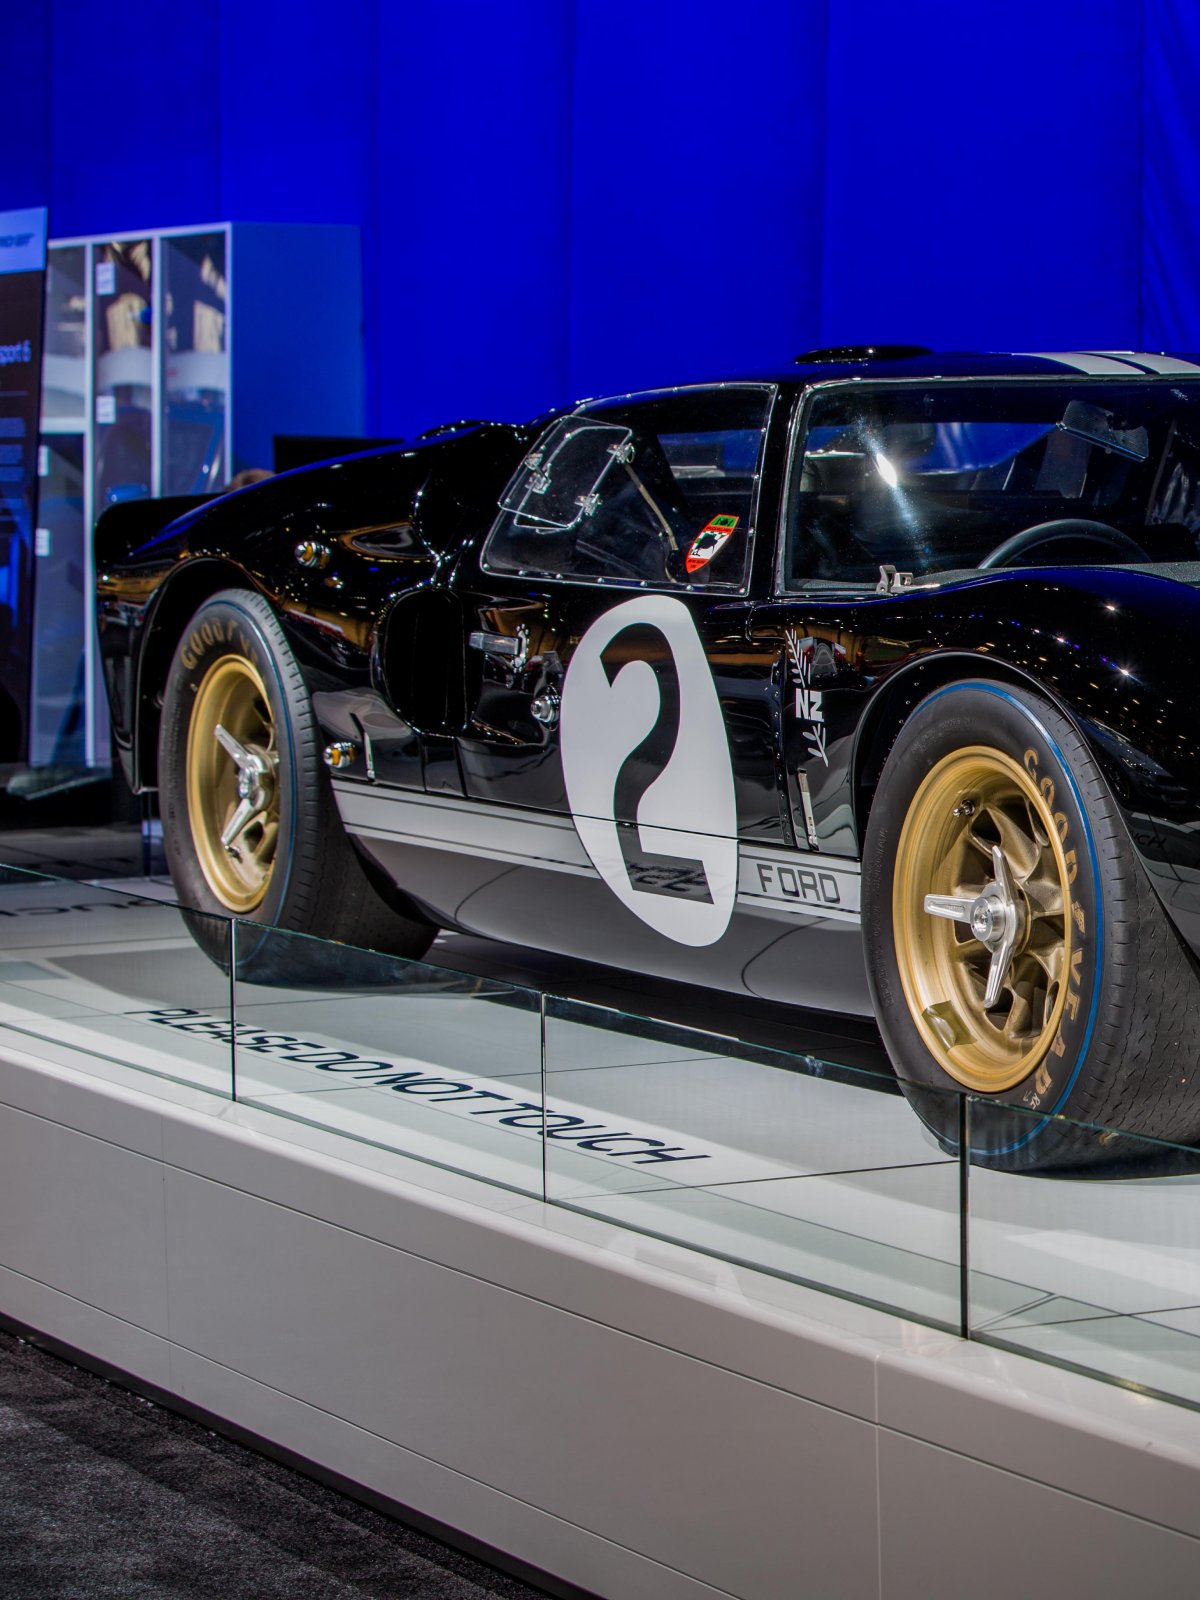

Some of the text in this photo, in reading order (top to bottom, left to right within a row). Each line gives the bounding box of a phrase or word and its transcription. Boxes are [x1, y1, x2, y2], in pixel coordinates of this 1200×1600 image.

[599, 622, 715, 905] 2
[757, 863, 841, 904] FORD
[123, 1008, 713, 1164] PLEASE DO NOT TOUCH
